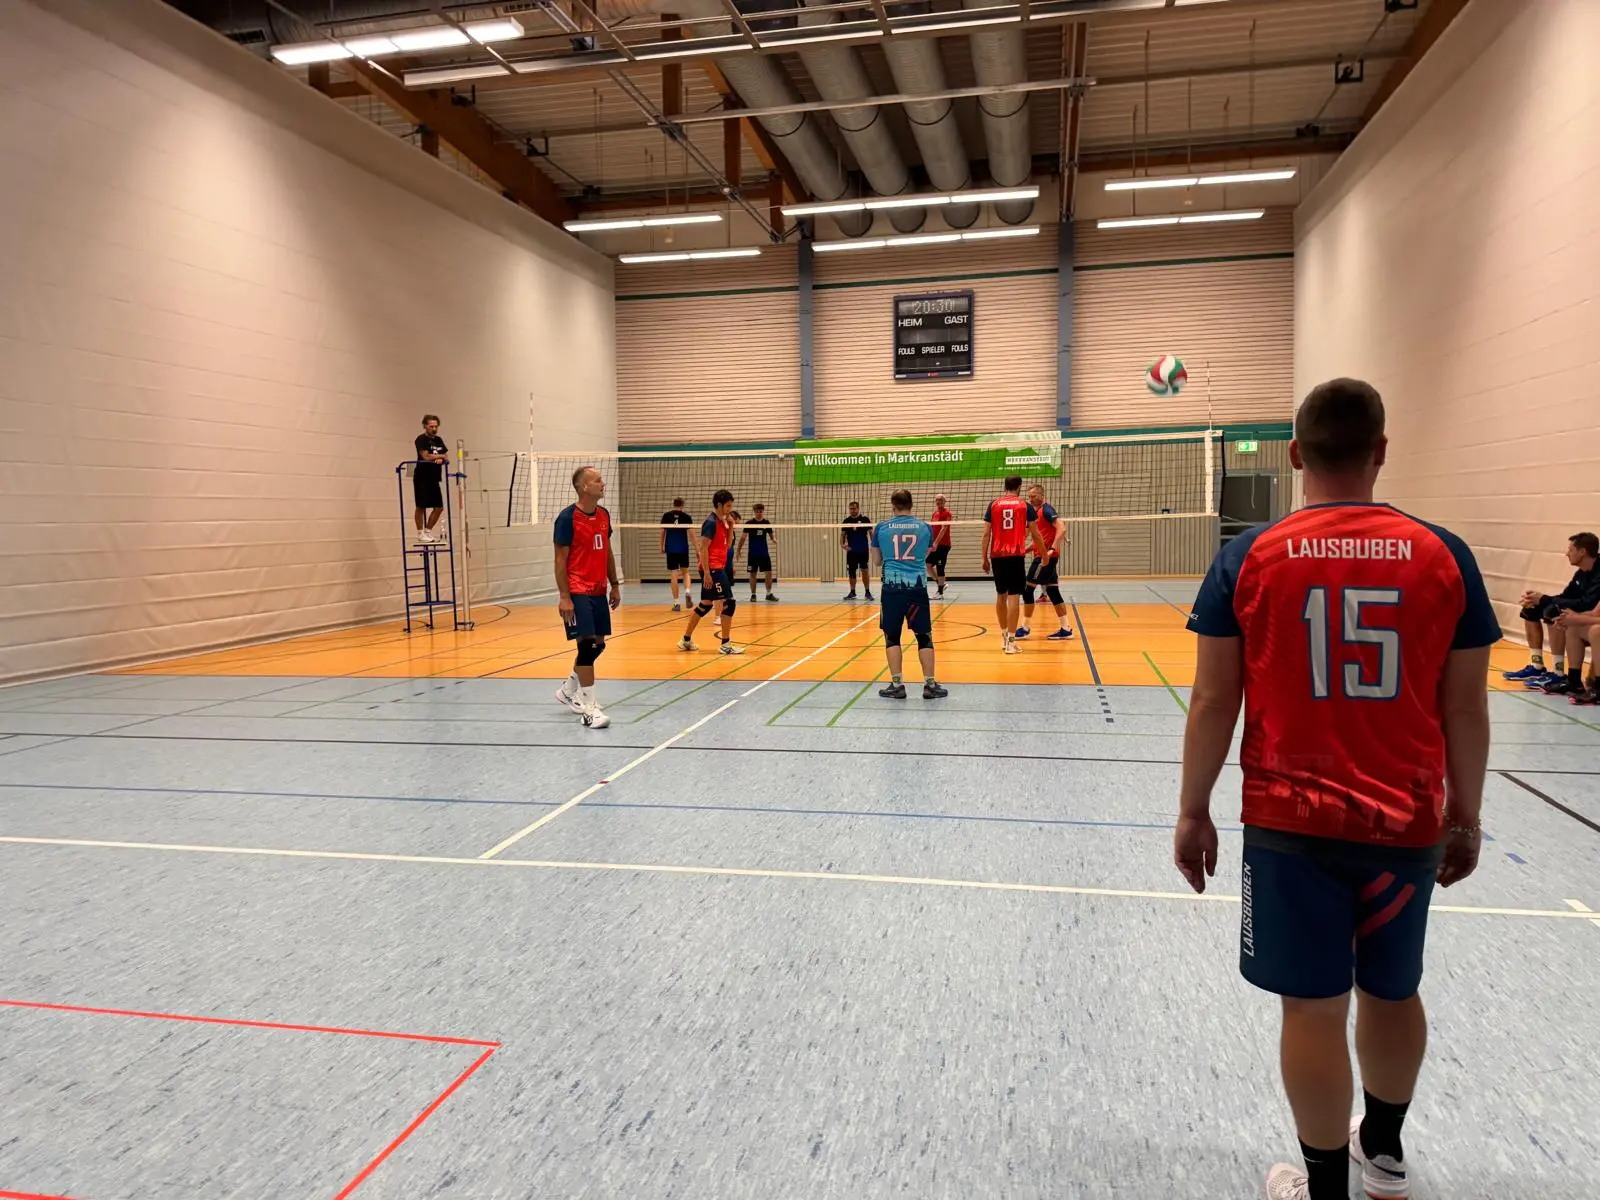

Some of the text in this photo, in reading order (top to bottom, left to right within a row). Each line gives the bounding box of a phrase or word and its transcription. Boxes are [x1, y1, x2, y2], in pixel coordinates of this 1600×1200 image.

[898, 318, 922, 327] HEIM
[944, 315, 968, 324] GAST
[898, 347, 916, 355] FOULS
[921, 345, 945, 354] SPIELER
[951, 344, 969, 352] FOULS
[803, 450, 963, 466] Willkommen in Markranstädt
[1002, 508, 1014, 530] 8
[892, 534, 917, 560] 12
[1287, 538, 1412, 560] LAUSBUBEN
[715, 582, 722, 593] 5
[1302, 586, 1402, 700] 15
[1243, 862, 1255, 957] LAUSBUBEN
